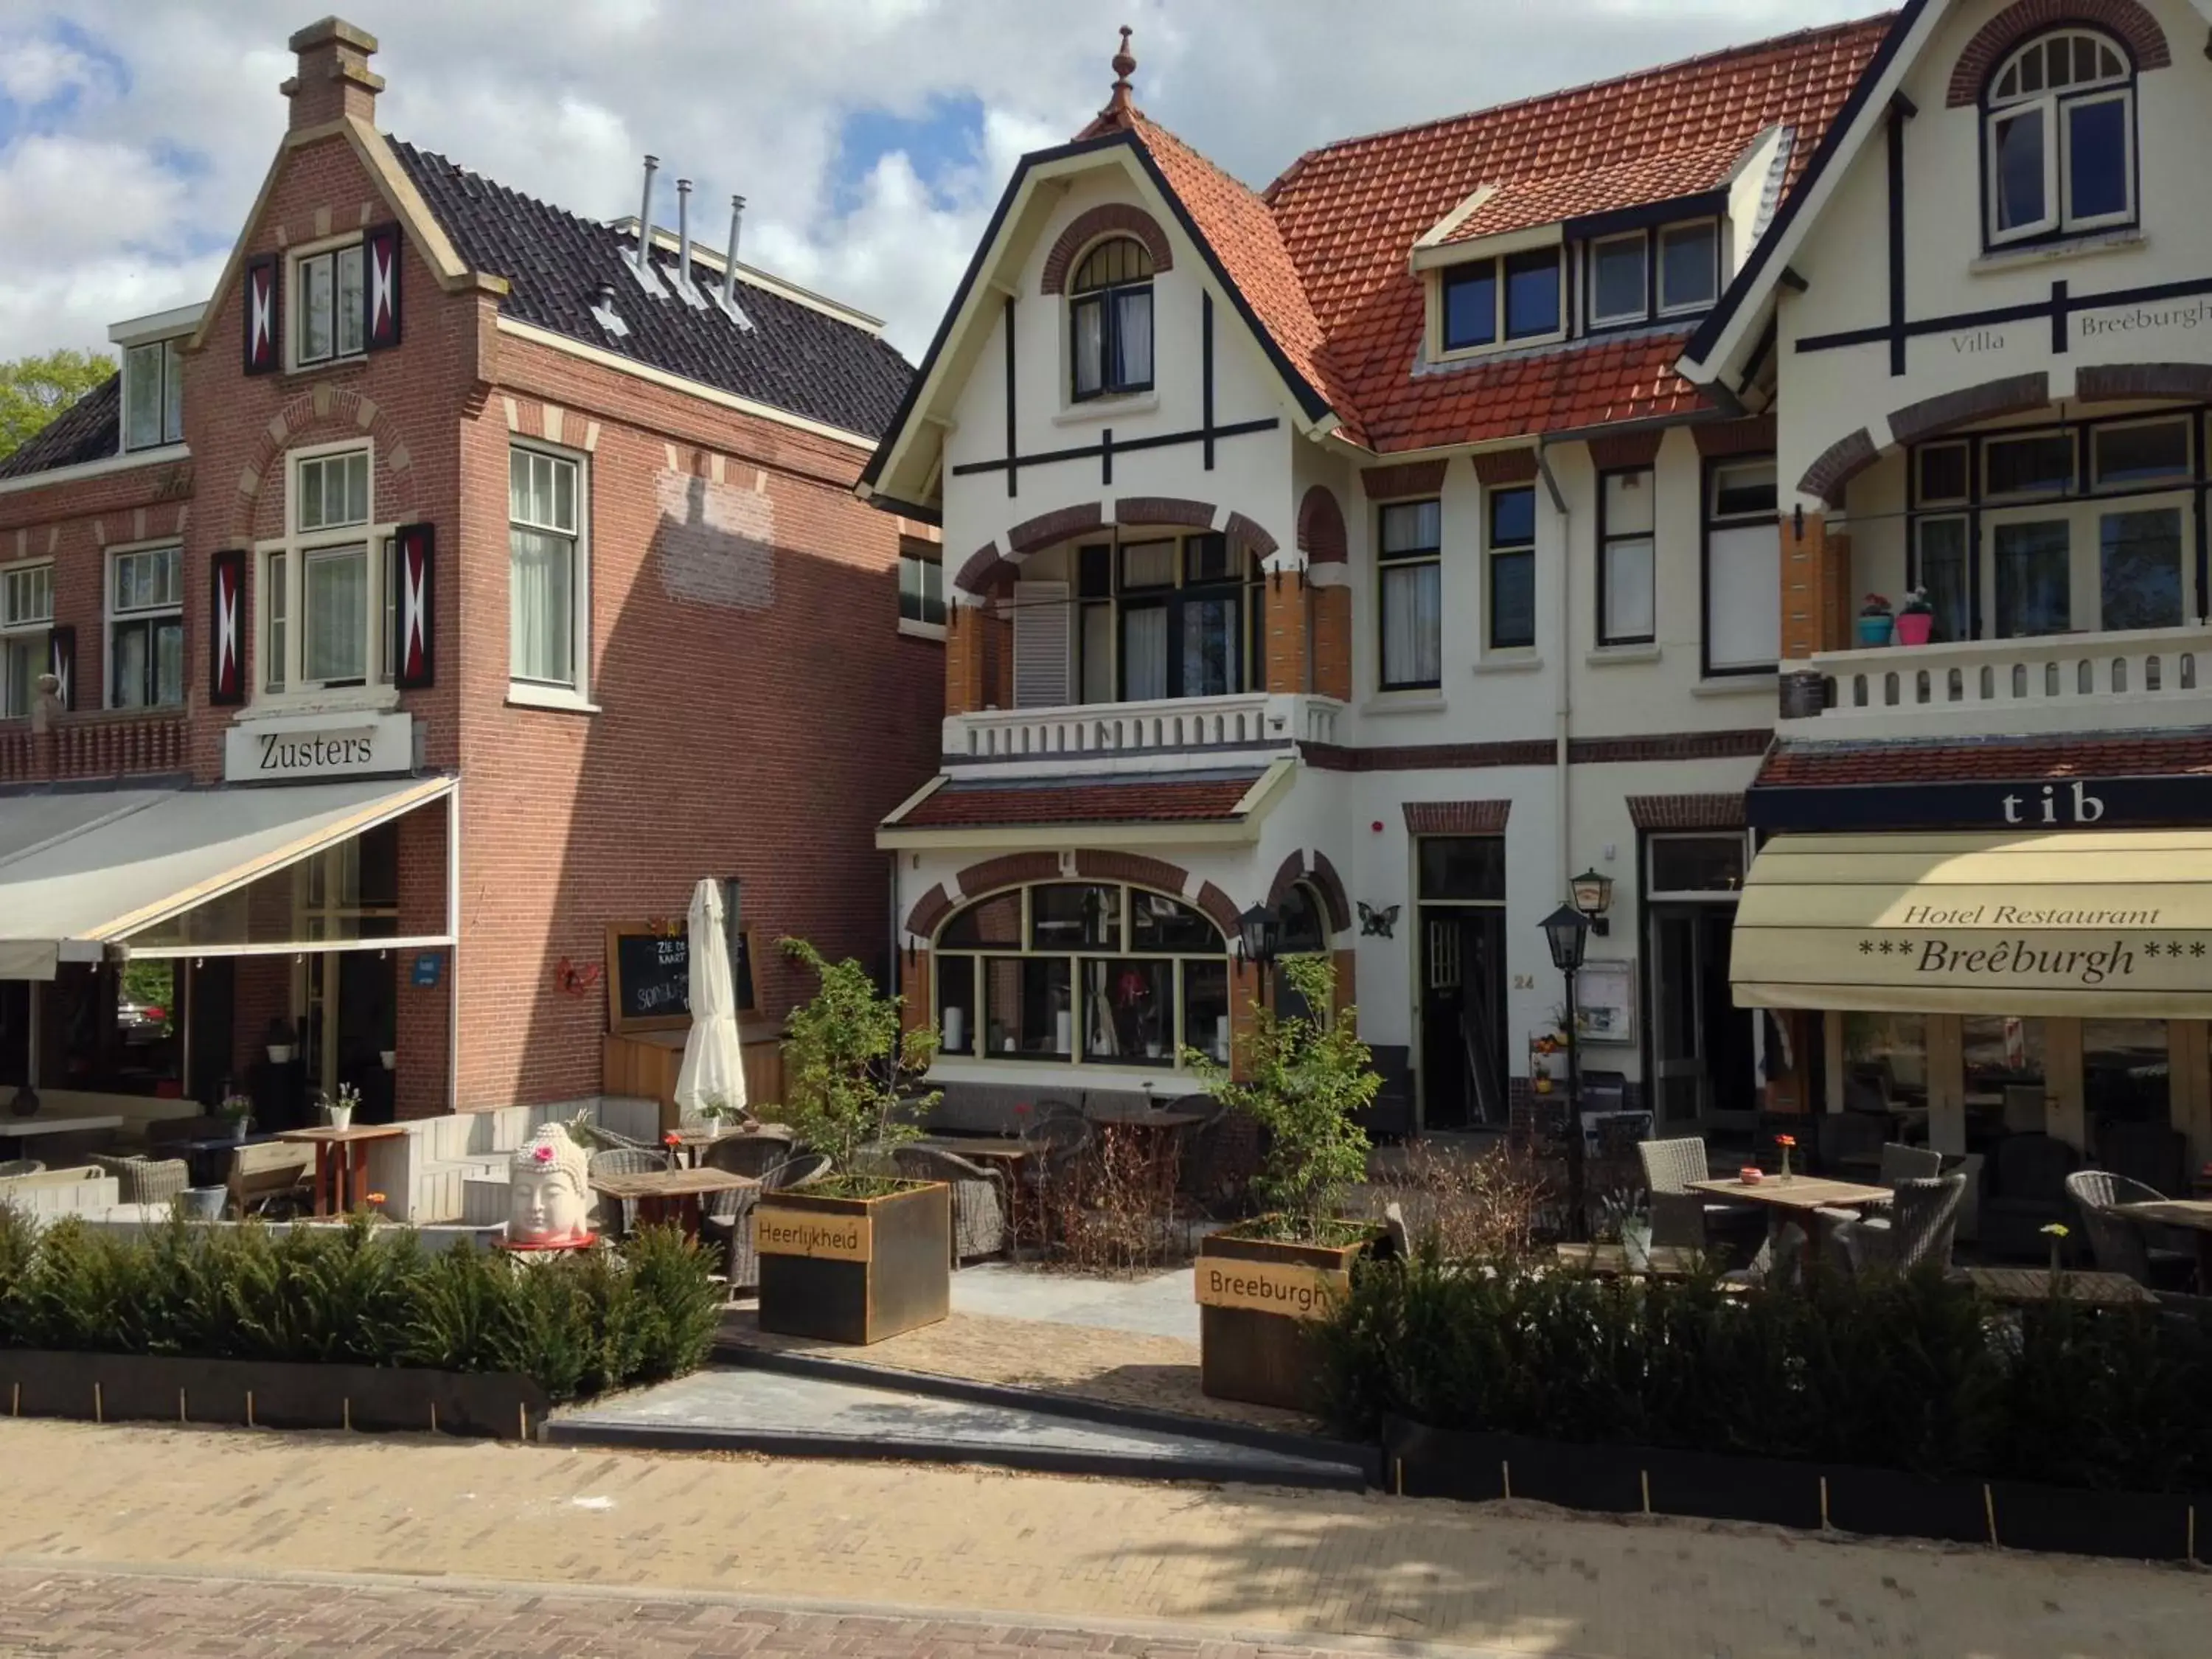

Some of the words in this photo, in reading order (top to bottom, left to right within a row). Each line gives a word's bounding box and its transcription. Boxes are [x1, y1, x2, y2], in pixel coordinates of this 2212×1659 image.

[1951, 331, 2004, 354] Villa
[260, 733, 372, 769] Zusters
[1902, 904, 1986, 925] Hotel
[1992, 905, 2161, 925] Restaurant
[759, 1222, 858, 1251] Heerlijkheid
[1209, 1270, 1327, 1312] Breeburgh
